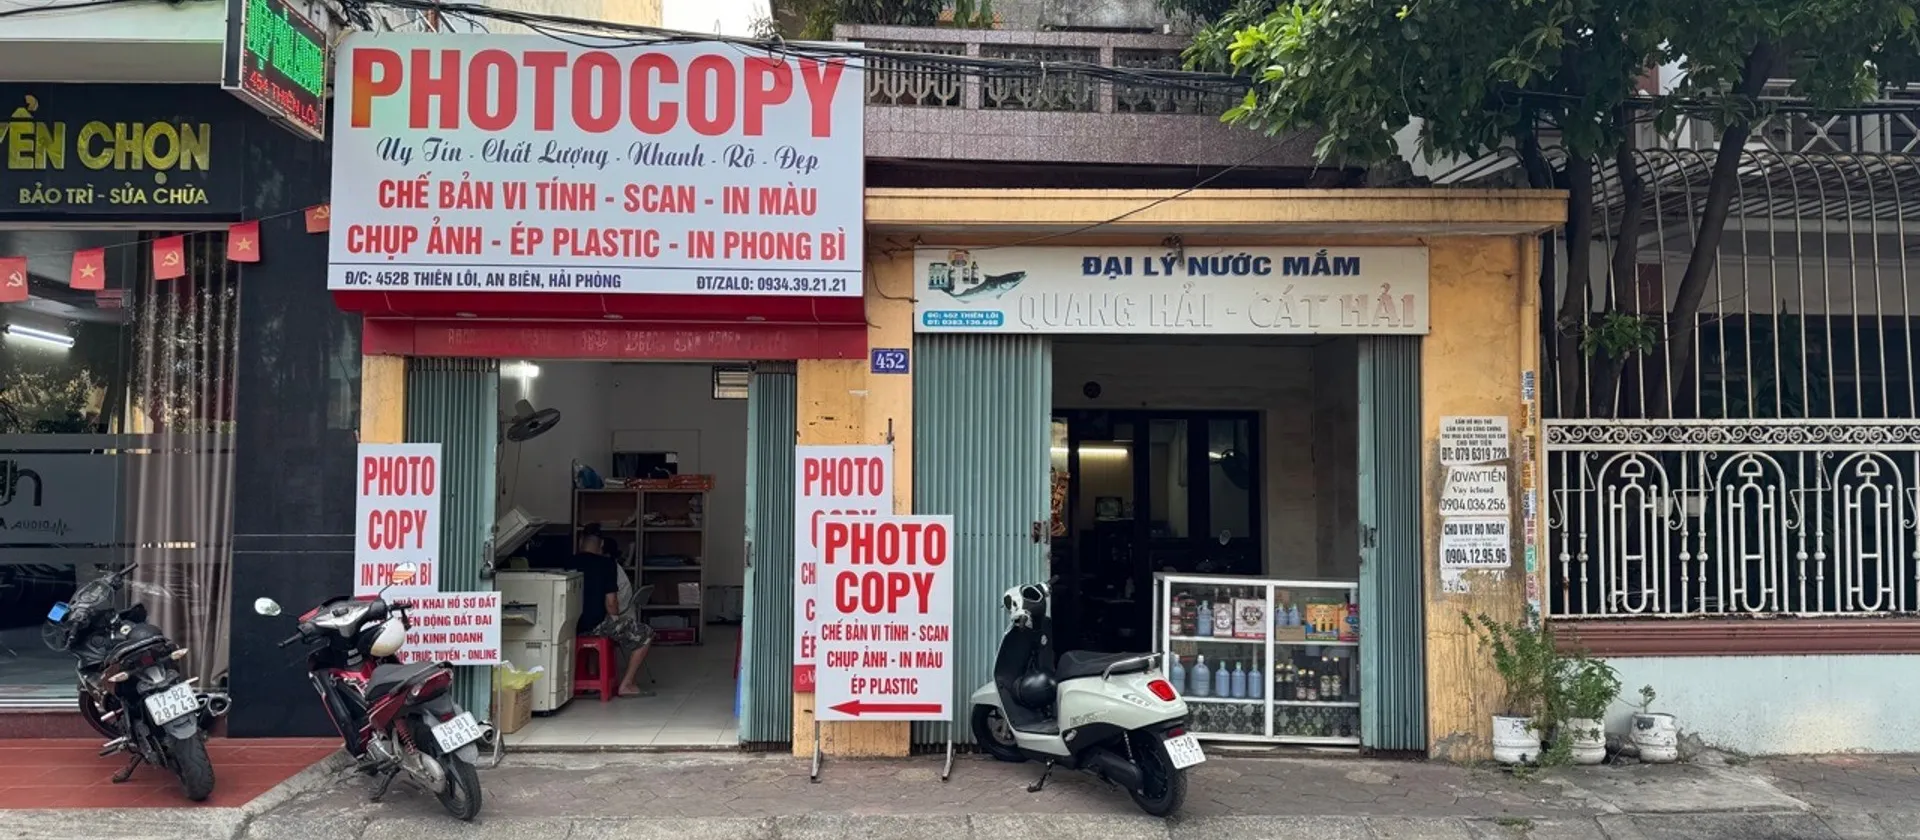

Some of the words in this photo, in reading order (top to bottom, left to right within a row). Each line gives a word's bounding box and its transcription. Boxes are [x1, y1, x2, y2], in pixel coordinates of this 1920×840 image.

[350, 47, 848, 138] PHOTOCOPY
[0, 94, 66, 170] ỂN
[77, 121, 211, 185] CHỌN
[376, 136, 413, 166] Uy
[422, 137, 464, 163] Tín
[482, 137, 534, 164] Chất
[537, 139, 610, 171] Lượng
[628, 141, 706, 168] Nhanh
[723, 144, 758, 168] Rõ
[774, 145, 820, 175] Đẹp
[19, 182, 62, 204] BẢO
[66, 183, 94, 204] TRÌ
[109, 181, 148, 204] SỬA
[153, 184, 209, 204] CHỮA
[378, 171, 432, 209] CHẾ
[439, 171, 494, 210] BẢN
[502, 181, 527, 210] VI
[535, 176, 596, 212] TÍNH
[624, 183, 696, 214] SCAN
[723, 186, 750, 215] IN
[759, 181, 817, 217] MÀU
[346, 224, 418, 261] CHỤP
[426, 216, 483, 255] ẢNH
[510, 221, 544, 256] ÉP
[552, 228, 661, 258] PLASTIC
[687, 230, 715, 259] IN
[723, 231, 812, 262] PHONG
[821, 226, 846, 261] BÌ
[1081, 256, 1134, 280] ĐẠI
[1143, 252, 1178, 277] LÝ
[1187, 252, 1272, 277] NƯỚC
[1283, 248, 1361, 276] MẮM
[345, 270, 372, 286] Đ/C:
[375, 271, 409, 286] 452B
[413, 269, 452, 287] THIÊN
[456, 269, 482, 288] LÔI,
[485, 272, 507, 287] AN
[508, 270, 545, 289] BIÊN,
[549, 270, 573, 288] HẢI
[576, 273, 621, 288] PHÒNG
[696, 275, 754, 291] ĐT/ZALO:
[757, 277, 847, 292] 0934.39.21.21
[1018, 292, 1137, 330] QUANG
[1149, 281, 1214, 328] HẢI
[1247, 283, 1329, 329] CÁT
[1340, 282, 1417, 328] HẢI
[875, 352, 906, 369] 452
[1455, 447, 1470, 461] 079
[1472, 447, 1491, 461] 6319
[363, 456, 436, 497] PHOTO
[803, 457, 884, 497] PHOTO
[1440, 498, 1506, 511] 0904.036.256
[368, 509, 428, 550] COPY
[1444, 524, 1458, 536] CHO
[1460, 524, 1473, 536] VAY
[825, 522, 947, 567] PHOTO
[1446, 548, 1507, 564] 0904.12.95.96
[361, 563, 374, 586] IN
[420, 558, 432, 586] BÌ
[801, 562, 816, 585] CH
[422, 598, 445, 610] KHAI
[447, 595, 461, 609] HỒ
[463, 598, 477, 609] SƠ
[478, 594, 497, 608] ĐẤT
[835, 570, 936, 615] COPY
[424, 614, 451, 629] ĐỘNG
[454, 611, 473, 626] ĐẤT
[475, 615, 492, 626] ĐAI
[821, 618, 844, 642] CHẾ
[845, 618, 869, 641] BẢN
[871, 624, 882, 641] VI
[884, 621, 909, 642] TÍNH
[919, 625, 949, 642] SCAN
[406, 632, 420, 647] HỘ
[422, 633, 446, 644] KINH
[449, 632, 483, 643] DOANH
[411, 649, 432, 662] TRỰC
[434, 647, 460, 661] TUYẾN
[468, 648, 498, 660] ONLINE
[827, 651, 859, 671] CHỤP
[862, 645, 888, 668] ẢNH
[899, 651, 912, 668] IN
[916, 648, 943, 669] MÀU
[850, 674, 867, 694] ÉP
[869, 677, 919, 694] PLASTIC
[153, 687, 187, 708] 17-B2
[155, 697, 196, 722] 282.43
[440, 717, 470, 737] 15-B1
